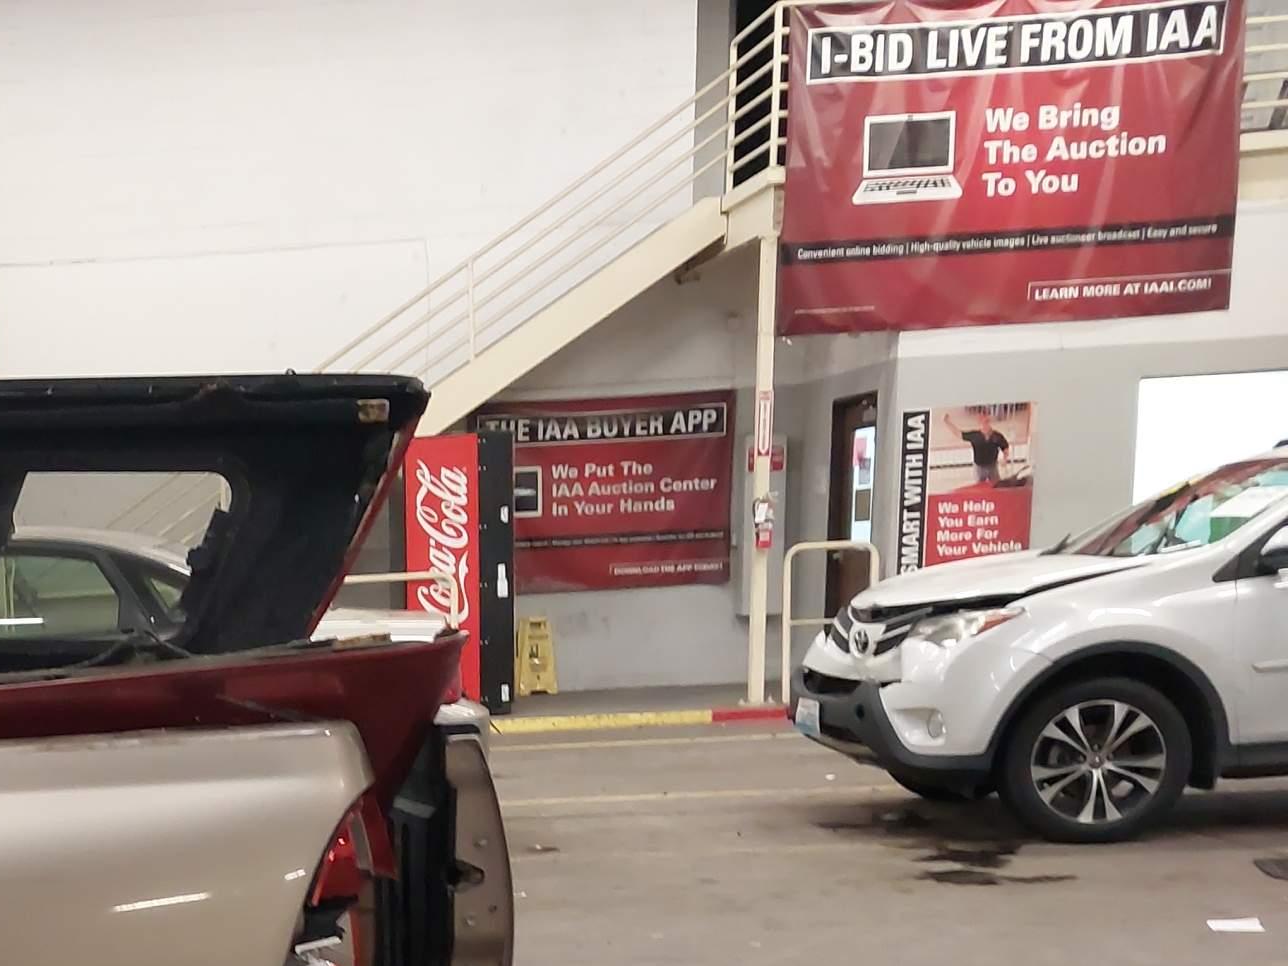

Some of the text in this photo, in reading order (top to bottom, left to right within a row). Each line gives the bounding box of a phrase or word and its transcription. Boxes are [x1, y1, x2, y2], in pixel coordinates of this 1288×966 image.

[821, 5, 1217, 74] I-BID LIVE FROM IAA
[985, 103, 1120, 132] We Bring
[984, 132, 1166, 164] The Auction
[982, 170, 1079, 197] To You
[798, 248, 845, 260] Convenient
[846, 246, 870, 256] online
[872, 243, 904, 256] bidding
[911, 239, 961, 253] High-quality
[962, 237, 991, 249] vehicle
[993, 235, 1025, 248] images
[1032, 233, 1049, 244] Live
[1169, 224, 1187, 237] and
[1034, 277, 1212, 300] LEARN MORE AT IAAI.COM!
[538, 416, 580, 441] IAA
[587, 413, 663, 438] BUYER
[670, 408, 718, 434] APP
[907, 413, 926, 450] IAA
[551, 460, 653, 479] We Put The
[905, 453, 924, 507] WITH
[551, 484, 584, 498] IAA
[588, 480, 655, 497] Auction
[660, 477, 717, 493] Center
[551, 497, 676, 517] In Your Hands
[938, 499, 995, 515] We Help
[938, 514, 999, 528] You Earn
[416, 458, 469, 625] Coca-Cola
[936, 528, 999, 542] More For
[936, 539, 1023, 557] Your Vehicle
